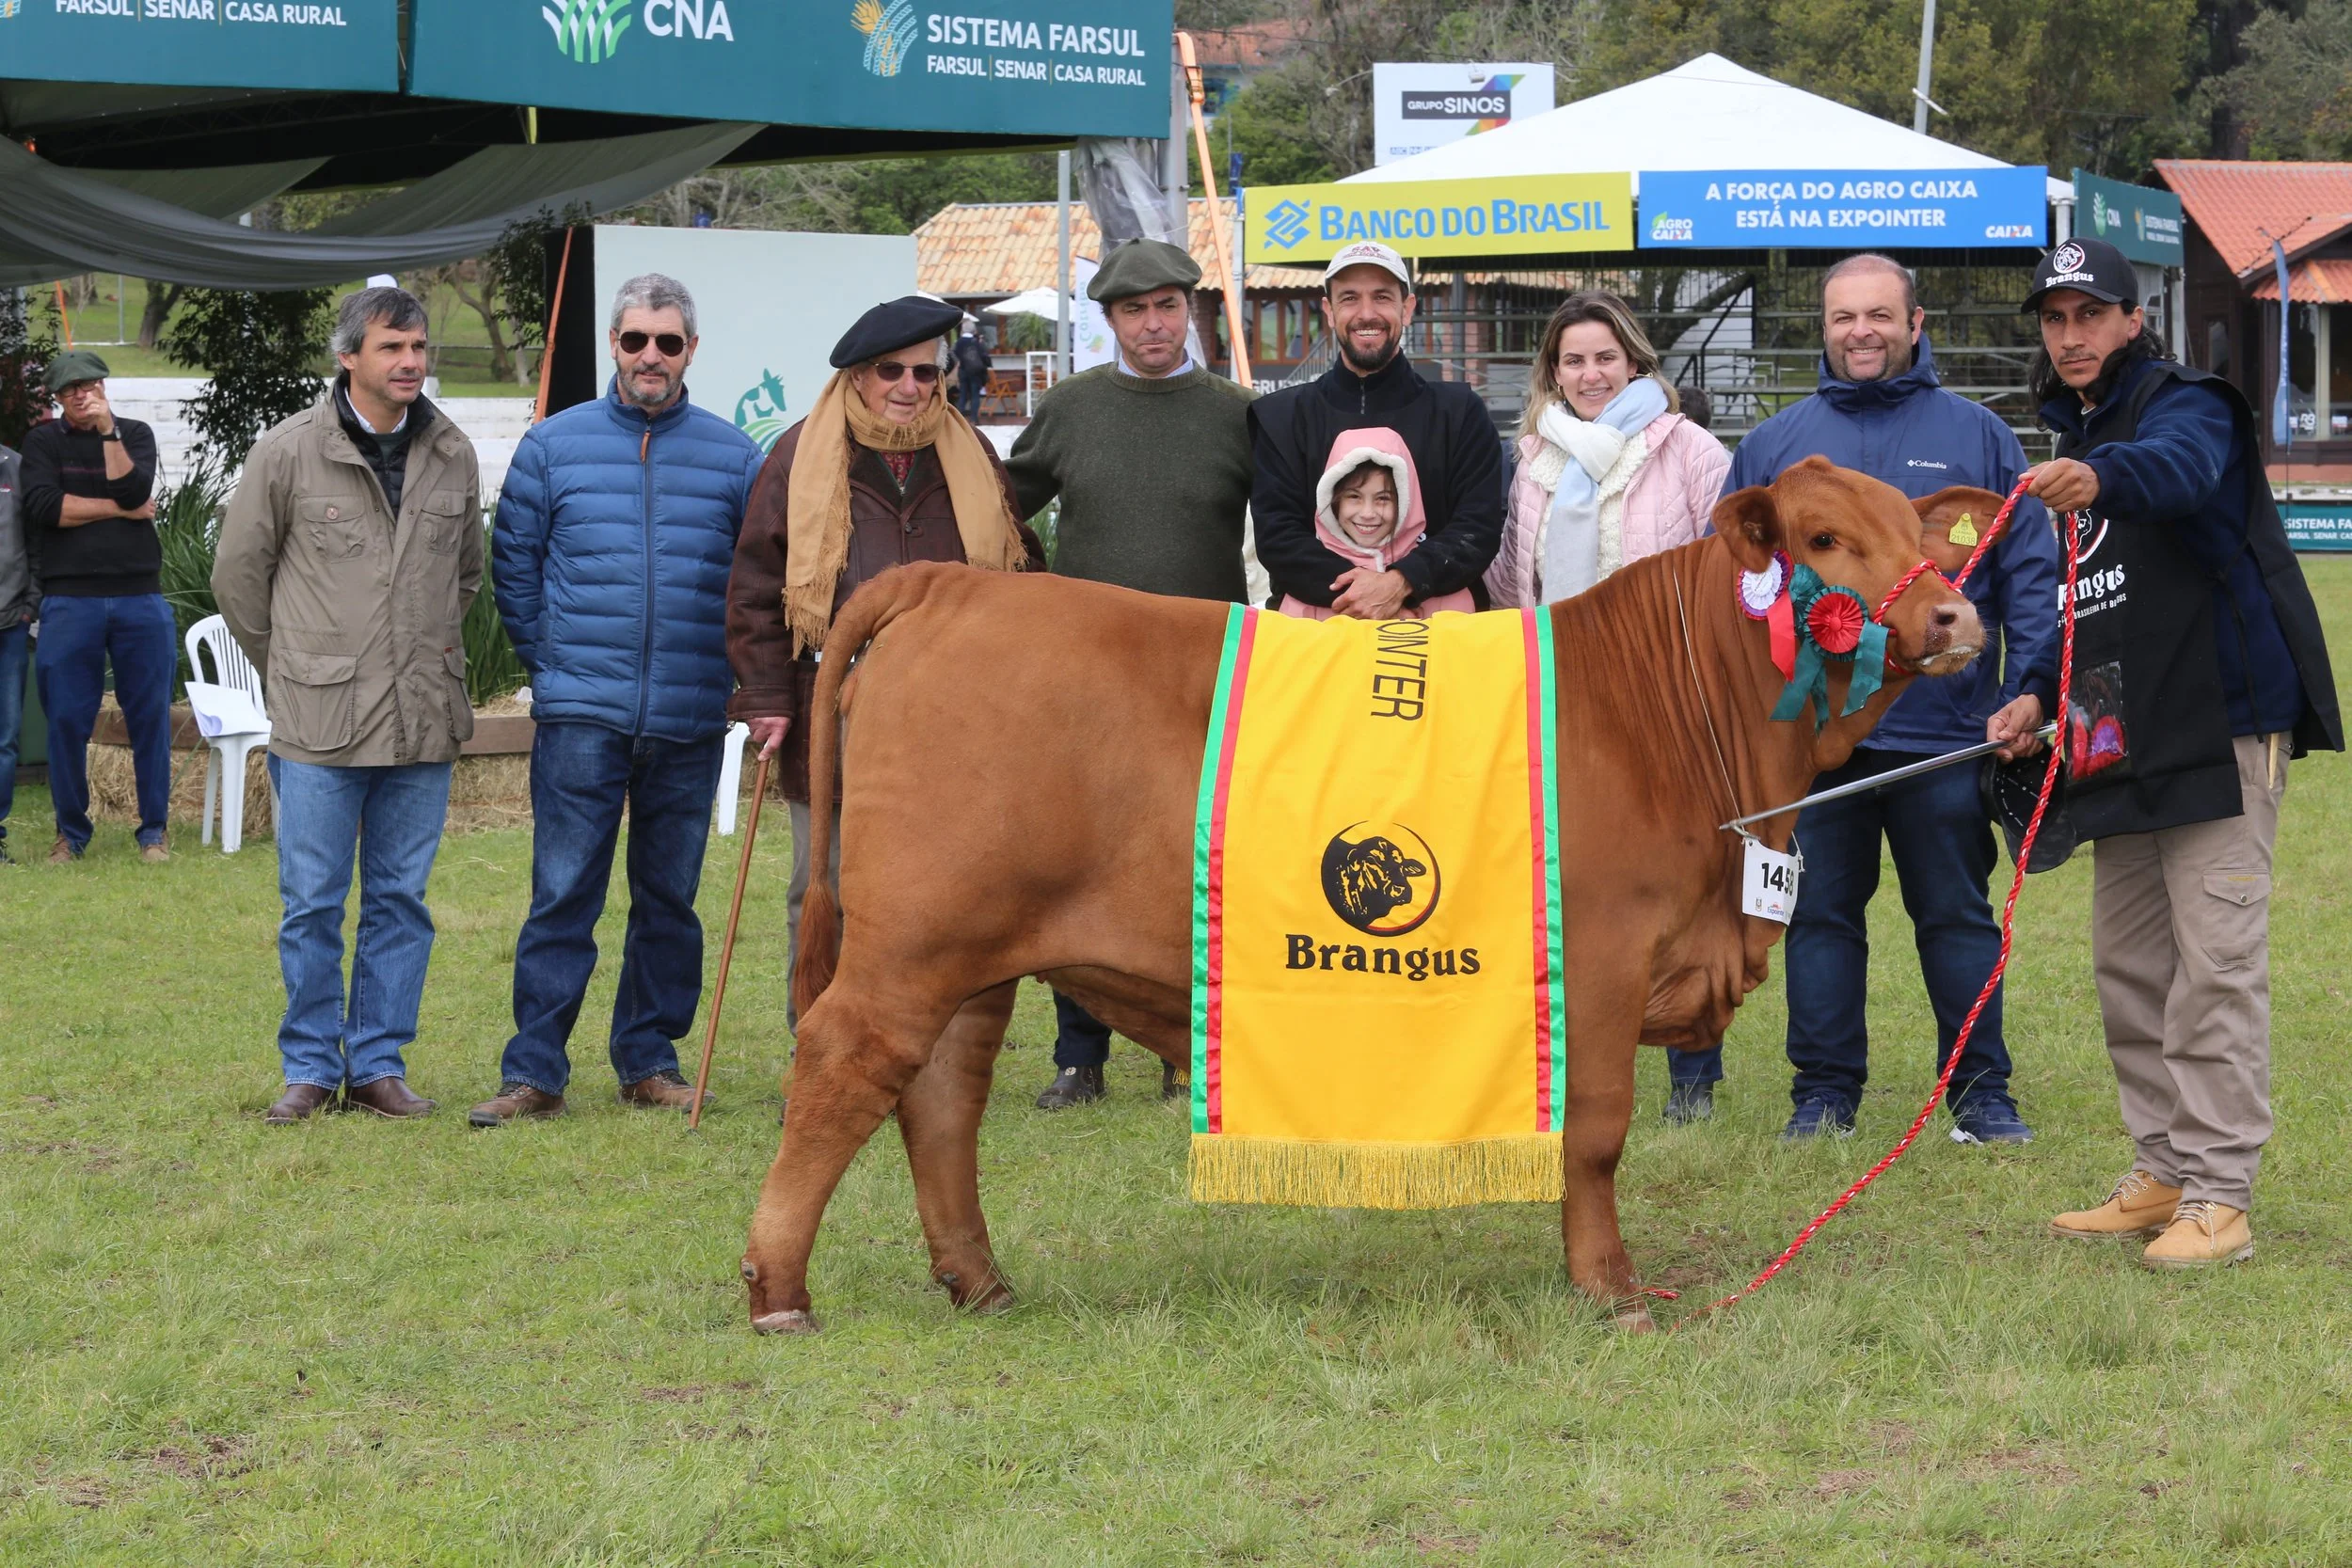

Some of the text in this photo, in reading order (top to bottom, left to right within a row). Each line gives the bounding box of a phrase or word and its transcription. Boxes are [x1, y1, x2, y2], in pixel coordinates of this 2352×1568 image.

[56, 0, 347, 26] FARSUL SENAR CASA RURAL
[644, 0, 734, 41] CNA
[928, 14, 1145, 56] SISTEMA FARSUL
[927, 55, 1146, 86] FARSUL SENAR CASA RURAL
[1407, 97, 1505, 114] GRUPO SINOS
[1705, 180, 1979, 205] A FORÇA DO AGRO CAIXA
[1320, 198, 1610, 241] BANCO DO BRASIL
[1656, 218, 1693, 230] AGRO
[1736, 204, 1947, 229] ESTÁ NA EXPOINTER
[1652, 229, 1693, 241] CAIXA
[1985, 225, 2034, 239] CAIXA
[2045, 271, 2094, 288] Brangus
[1915, 459, 1947, 469] Columbia
[2284, 518, 2336, 530] SISTEMA
[2287, 531, 2311, 540] ARSUL
[1951, 533, 1976, 546] 21038
[1371, 619, 1429, 721] OINTER
[1761, 863, 1795, 896] 1458
[1285, 932, 1481, 982] Brangus
